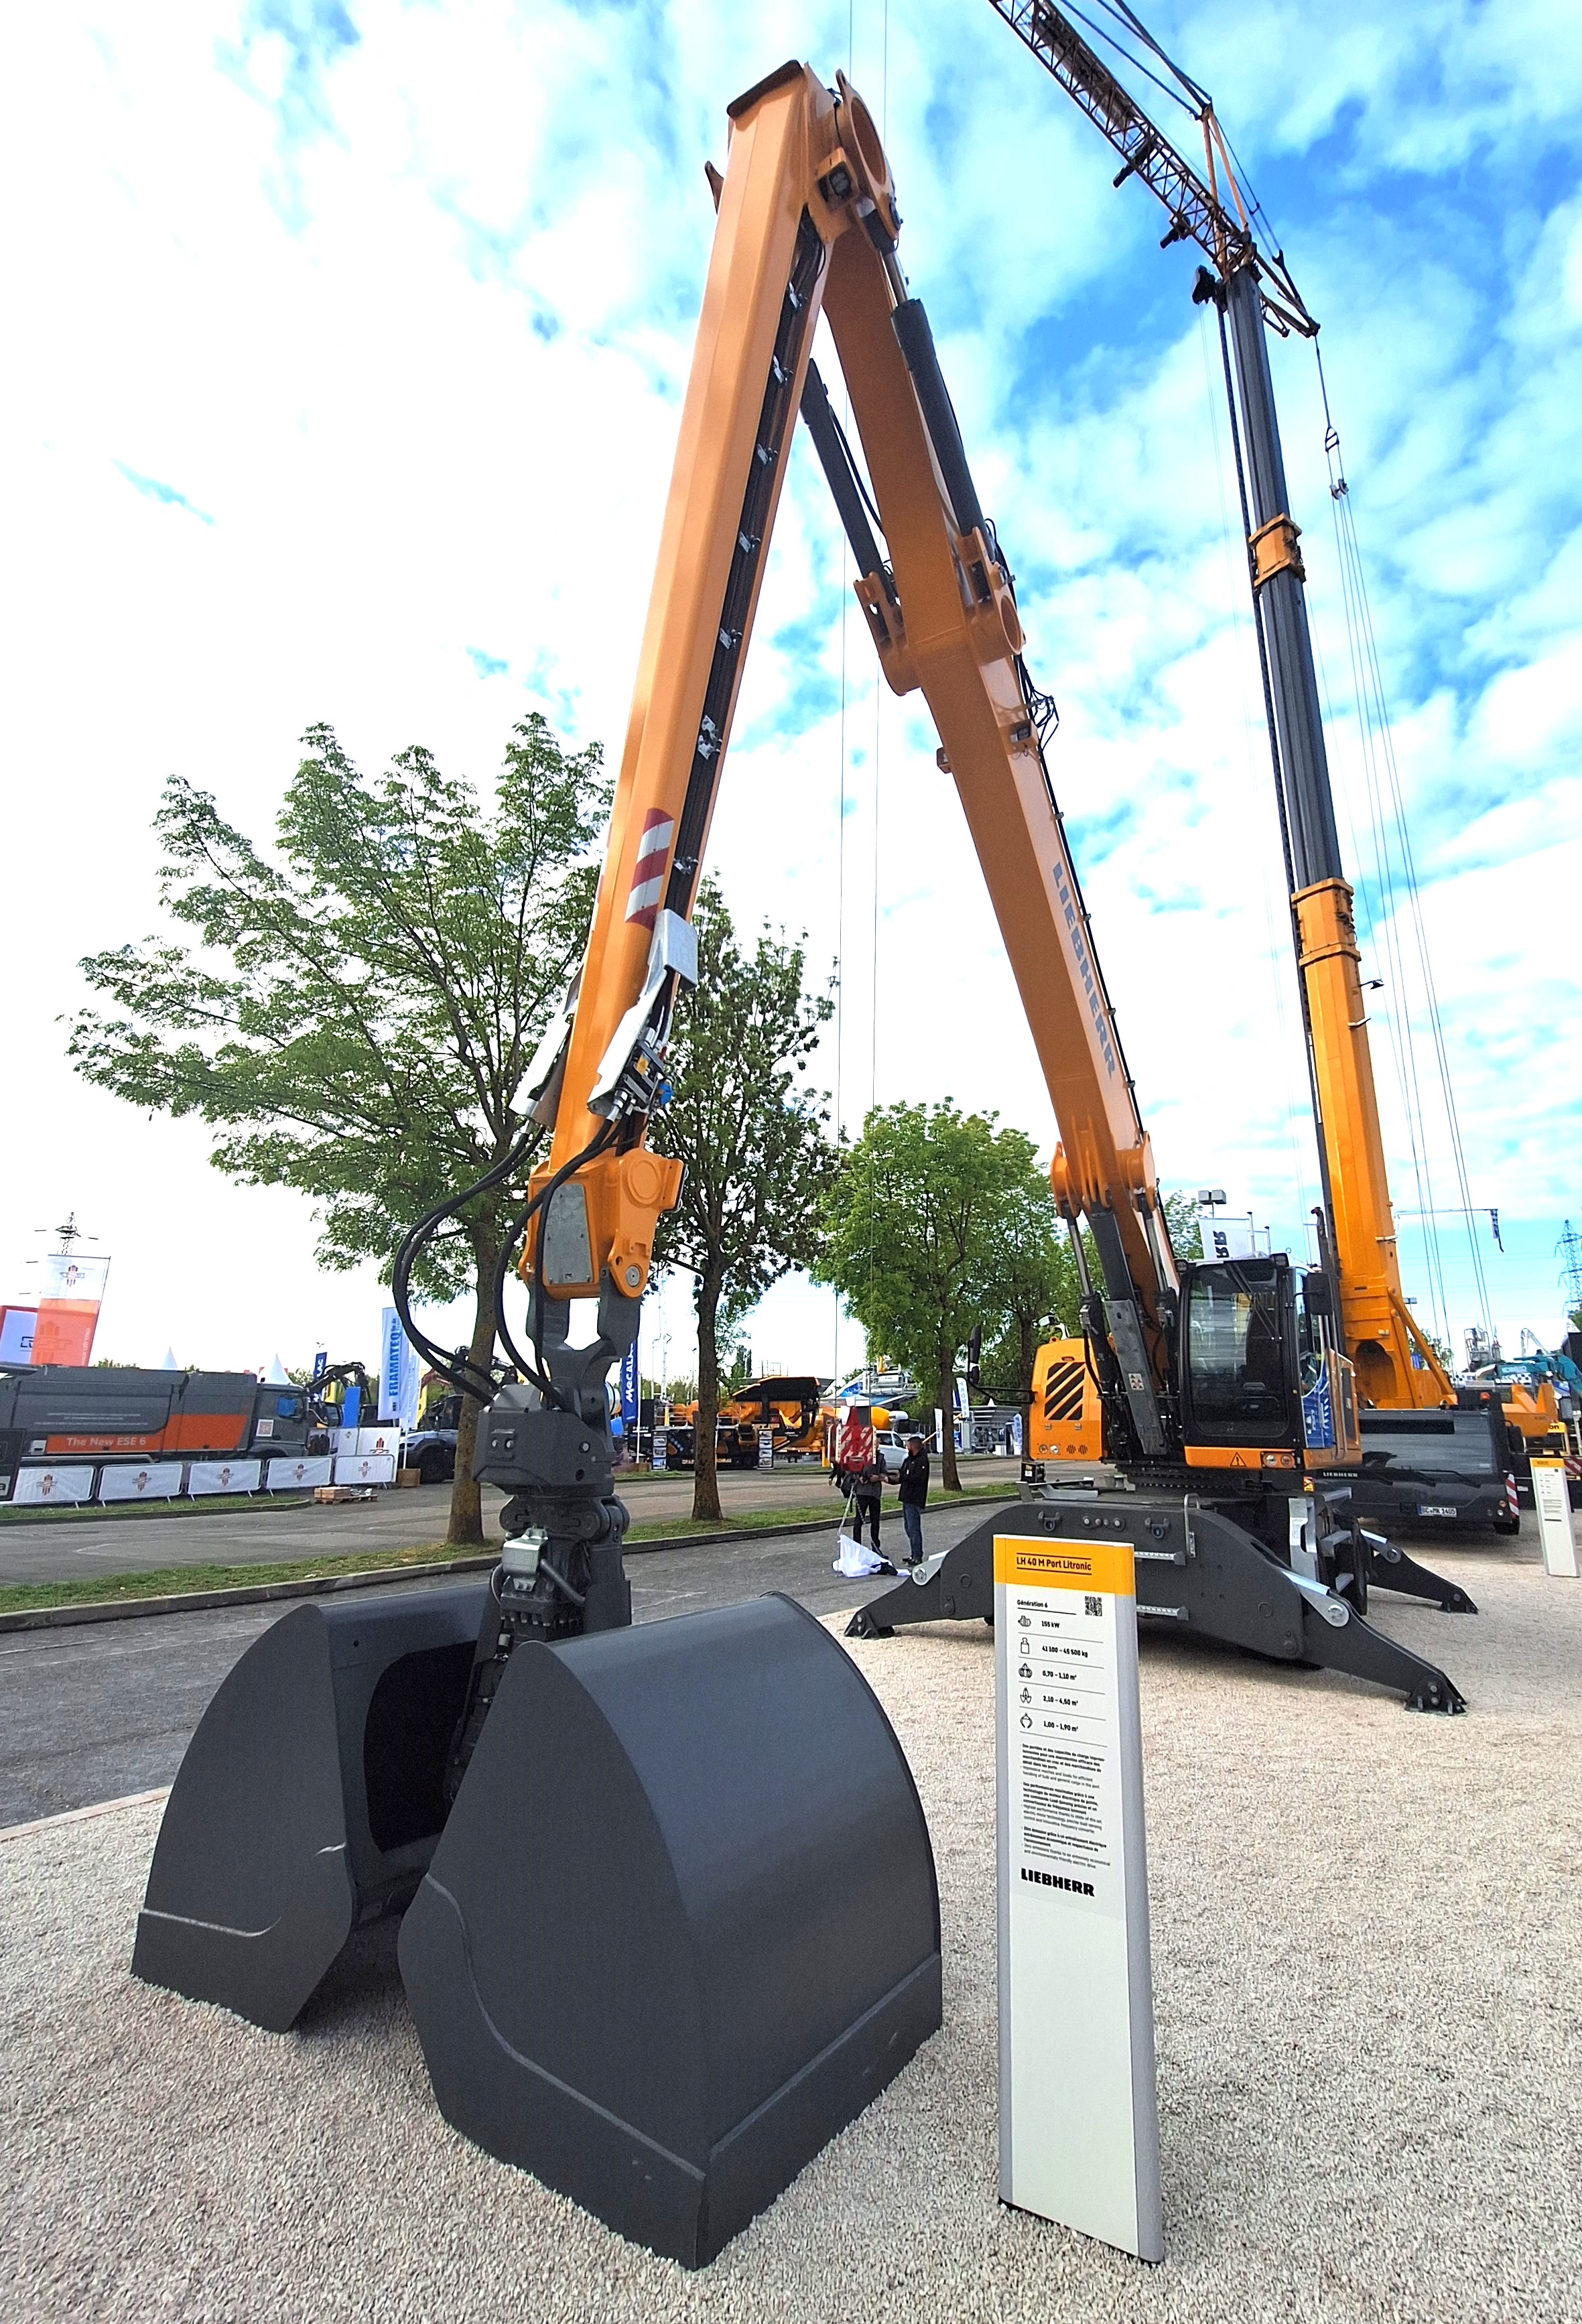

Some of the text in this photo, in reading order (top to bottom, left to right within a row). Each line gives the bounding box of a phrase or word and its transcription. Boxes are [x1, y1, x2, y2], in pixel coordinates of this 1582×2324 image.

[1053, 860, 1116, 1082] LIEBHERR
[67, 1437, 146, 1446] The New ESE 6
[1016, 1556, 1092, 1571] LH 40 M Port Litronic
[1017, 1599, 1044, 1608] Génération
[1081, 1650, 1088, 1658] kg
[1020, 1868, 1095, 1897] LIEBHERR
